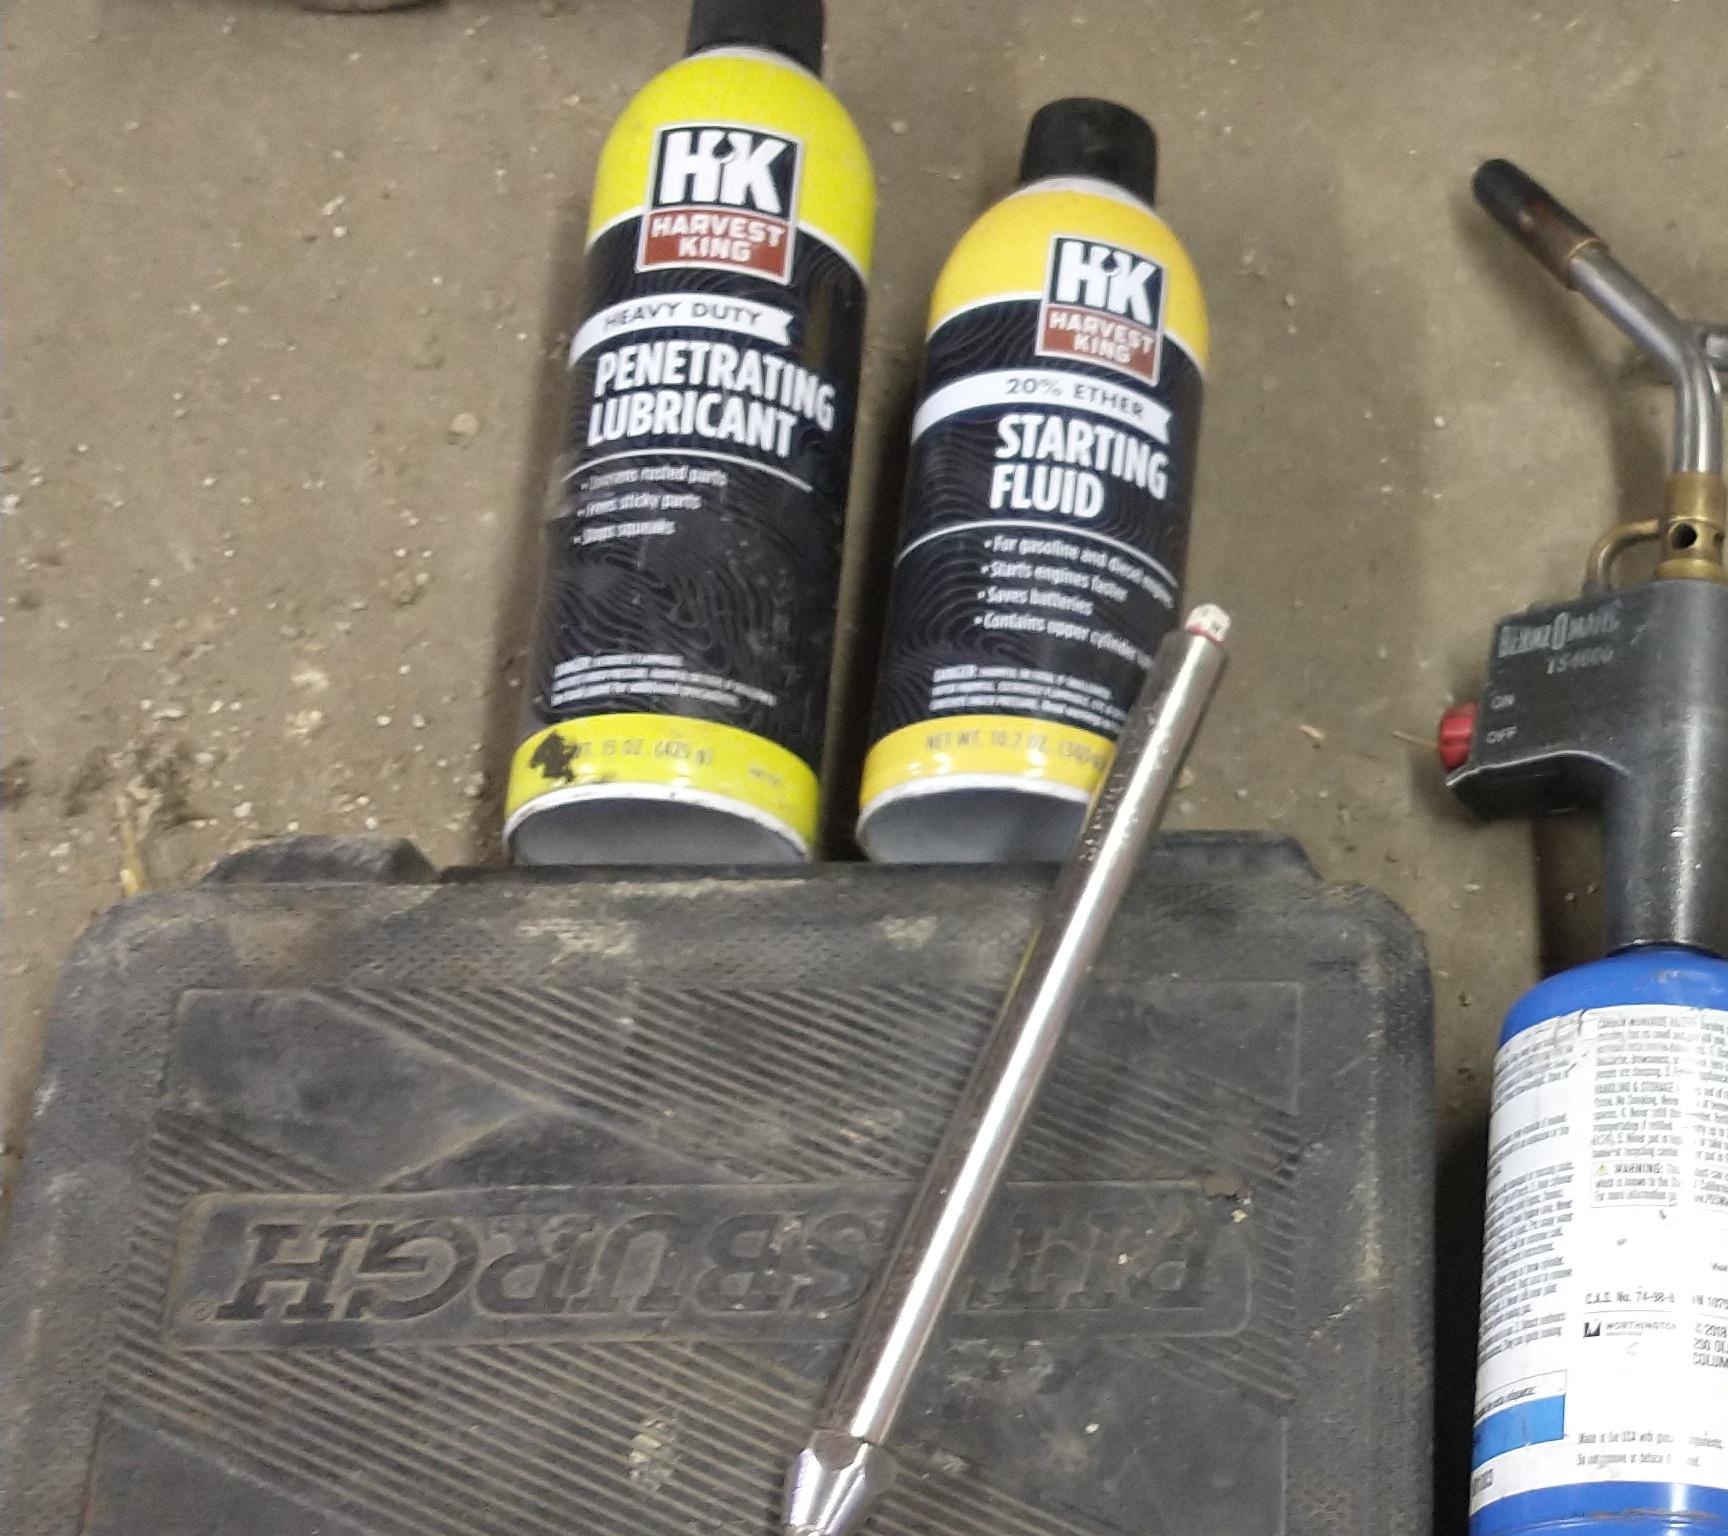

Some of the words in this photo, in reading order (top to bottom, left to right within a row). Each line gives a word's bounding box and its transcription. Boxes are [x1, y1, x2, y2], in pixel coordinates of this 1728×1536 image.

[659, 128, 788, 215] HK
[650, 213, 787, 248] HARVEST
[677, 235, 752, 263] KING
[1055, 239, 1158, 327] HK
[604, 301, 683, 330] HEAVY
[690, 302, 762, 326] DUTY
[1048, 310, 1156, 353] HARVEST
[1072, 331, 1133, 364] KING
[593, 339, 837, 433] PENETRATING
[1005, 376, 1063, 397] 20%
[1072, 382, 1146, 418] ETHER
[586, 389, 799, 459] LUBRICANT
[994, 413, 1170, 501] STARTING
[989, 463, 1106, 520] FLUID
[1018, 536, 1081, 561] gasoline
[1080, 548, 1109, 568] and
[1034, 564, 1091, 589] engines
[982, 610, 1047, 632] Contains
[1490, 693, 1515, 710] ON
[215, 1210, 1205, 1321] PITSBURGH
